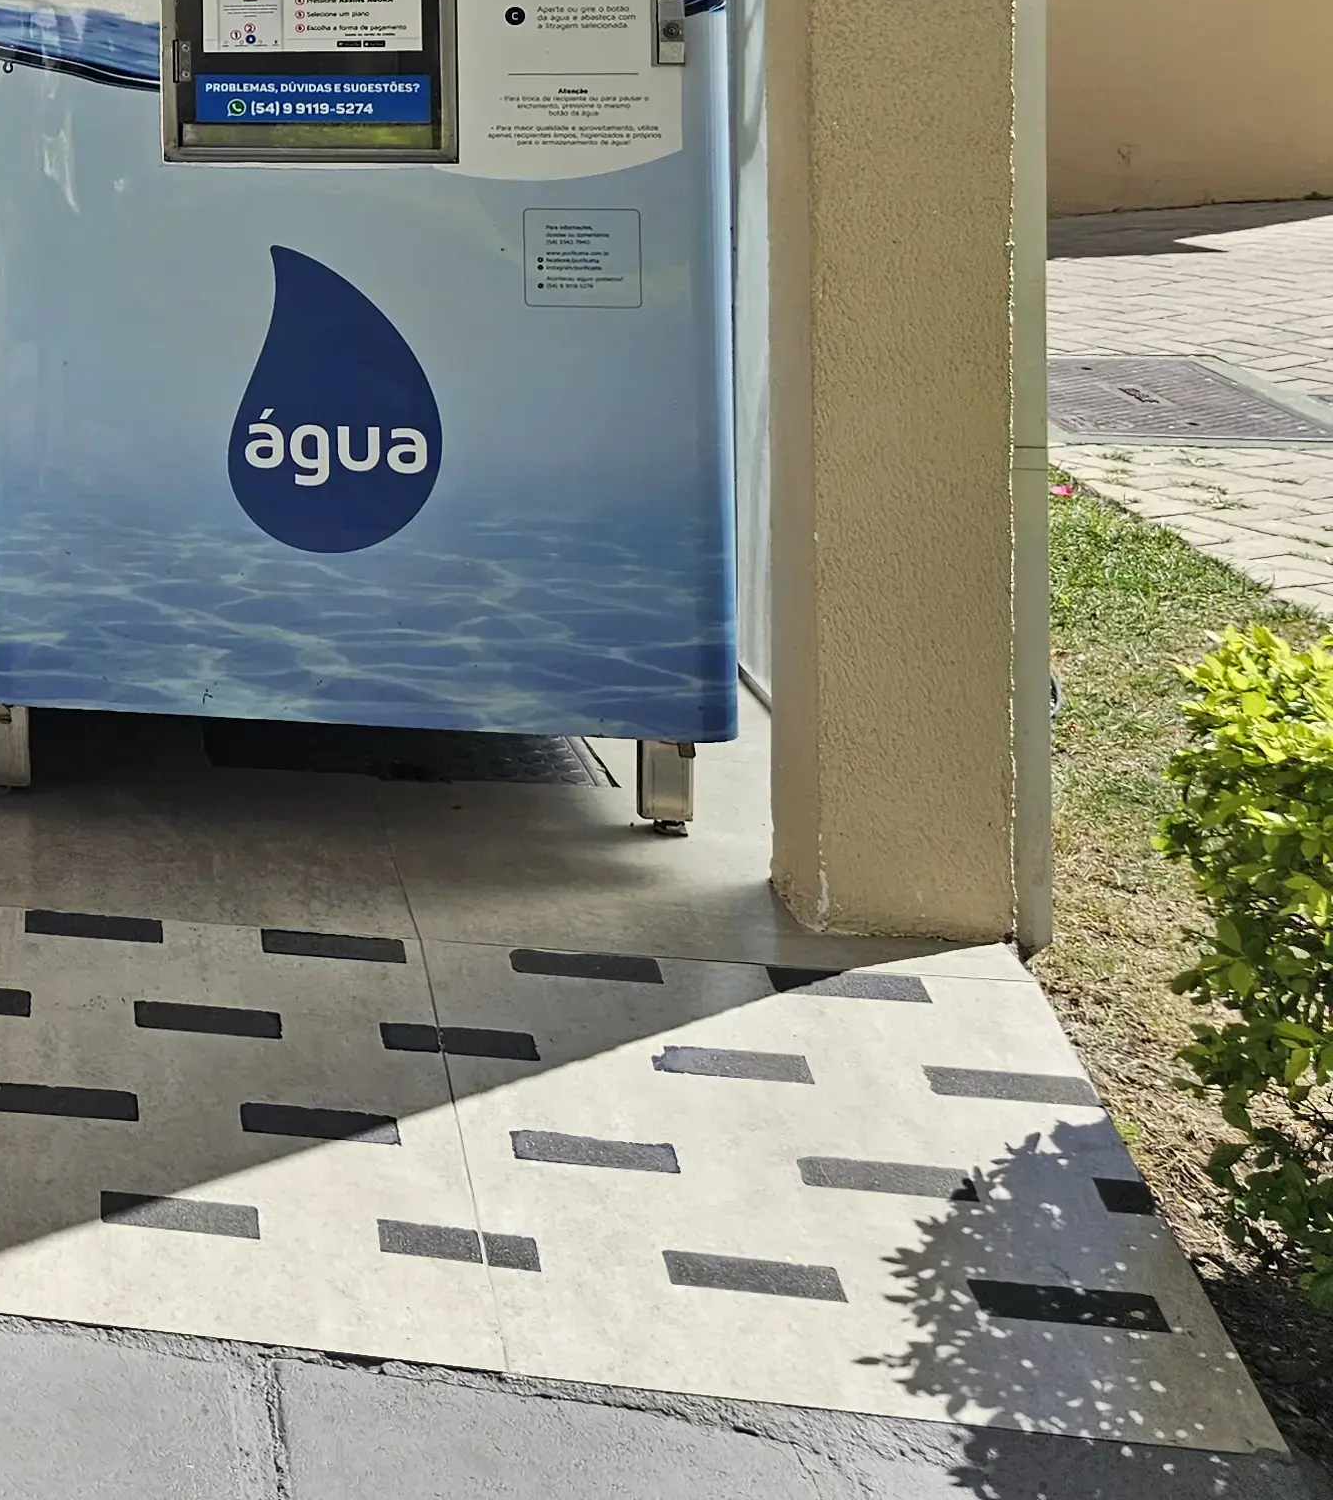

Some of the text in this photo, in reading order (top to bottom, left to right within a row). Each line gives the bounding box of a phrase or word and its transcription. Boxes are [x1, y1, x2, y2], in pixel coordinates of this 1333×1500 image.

[537, 6, 565, 14] Aperte
[511, 12, 519, 20] C
[370, 24, 407, 32] pagamento
[545, 22, 578, 30] litragem
[205, 81, 420, 94] PROBLEMAS, DÚVIDAS E SUGESTÕES?
[251, 101, 374, 116] (54) 9 9119-5274
[244, 408, 428, 486] água
